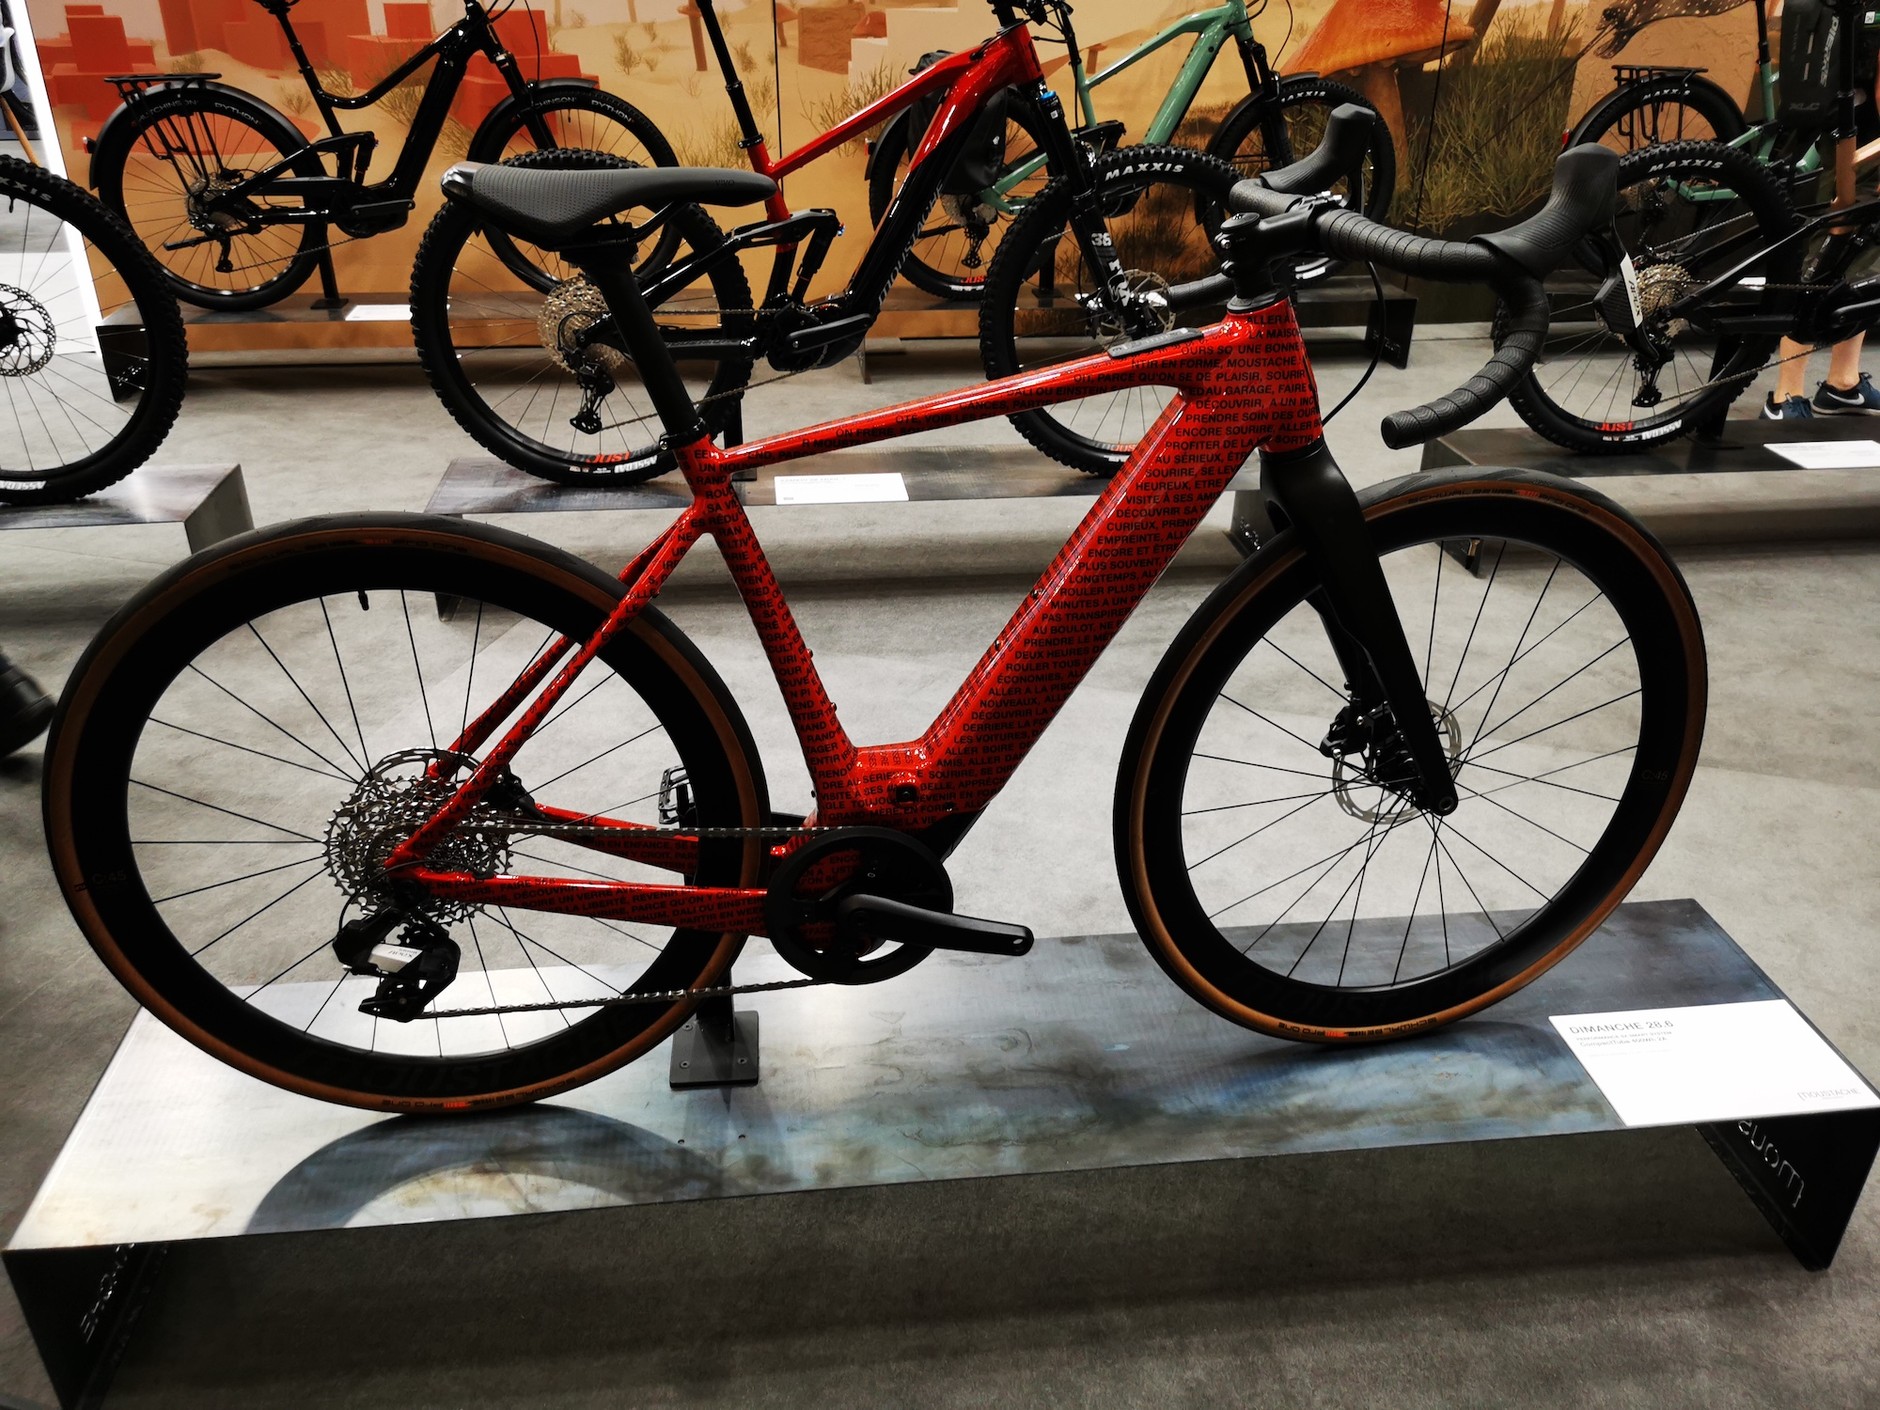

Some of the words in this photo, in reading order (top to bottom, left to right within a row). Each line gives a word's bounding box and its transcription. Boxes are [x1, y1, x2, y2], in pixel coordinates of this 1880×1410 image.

[1104, 161, 1185, 182] MAXXIS
[1648, 159, 1724, 174] MAXXIS
[1091, 231, 1112, 247] 36
[1237, 343, 1262, 354] UNE
[1265, 342, 1300, 353] BONNE
[1161, 359, 1177, 369] EN
[1226, 356, 1296, 368] MOUSTACHE
[1097, 372, 1136, 382] PARCE
[1138, 372, 1177, 382] QU'ON
[1179, 372, 1193, 381] SE
[1216, 371, 1263, 382] PLAISIR,
[1226, 384, 1275, 395] GARAGE,
[1280, 396, 1297, 406] UN
[1185, 412, 1239, 423] PRENDRE
[1241, 412, 1269, 422] SOIN
[1272, 410, 1294, 420] DES
[1175, 426, 1221, 437] ENCORE
[1280, 421, 1312, 432] ALLER
[1165, 439, 1221, 450] PROFITER
[1223, 440, 1238, 449] DE
[1155, 454, 1171, 465] AU
[1174, 453, 1224, 465] SÉRIEUX,
[1145, 467, 1198, 479] SOURIRE,
[1201, 467, 1214, 476] SE
[1135, 481, 1191, 492] HEUREUX,
[1126, 494, 1160, 505] VISITE
[1173, 493, 1194, 503] SES
[1116, 505, 1180, 519] DÉCOUVRIR
[1106, 521, 1159, 532] CURIEUX,
[1097, 531, 1163, 545] EMPREINTE,
[1088, 547, 1133, 558] ENCORE
[1137, 546, 1149, 555] ET
[1078, 560, 1107, 571] PLUS
[1060, 587, 1104, 597] ROULER
[1107, 584, 1135, 594] PLUS
[1051, 598, 1099, 610] MINUTES
[1112, 596, 1128, 605] UN
[1042, 612, 1062, 623] PAS
[1033, 626, 1047, 635] AU
[1024, 636, 1074, 647] PRENDRE
[1015, 650, 1044, 660] DEUX
[1046, 646, 1089, 658] HEURES
[1006, 661, 1050, 672] ROULER
[988, 686, 1024, 697] ALLER
[1035, 684, 1048, 694] LA
[971, 708, 1033, 720] DÉCOUVRIR
[954, 734, 973, 744] LES
[945, 746, 978, 755] ALLER
[1569, 1021, 1645, 1034] DIMANCHE
